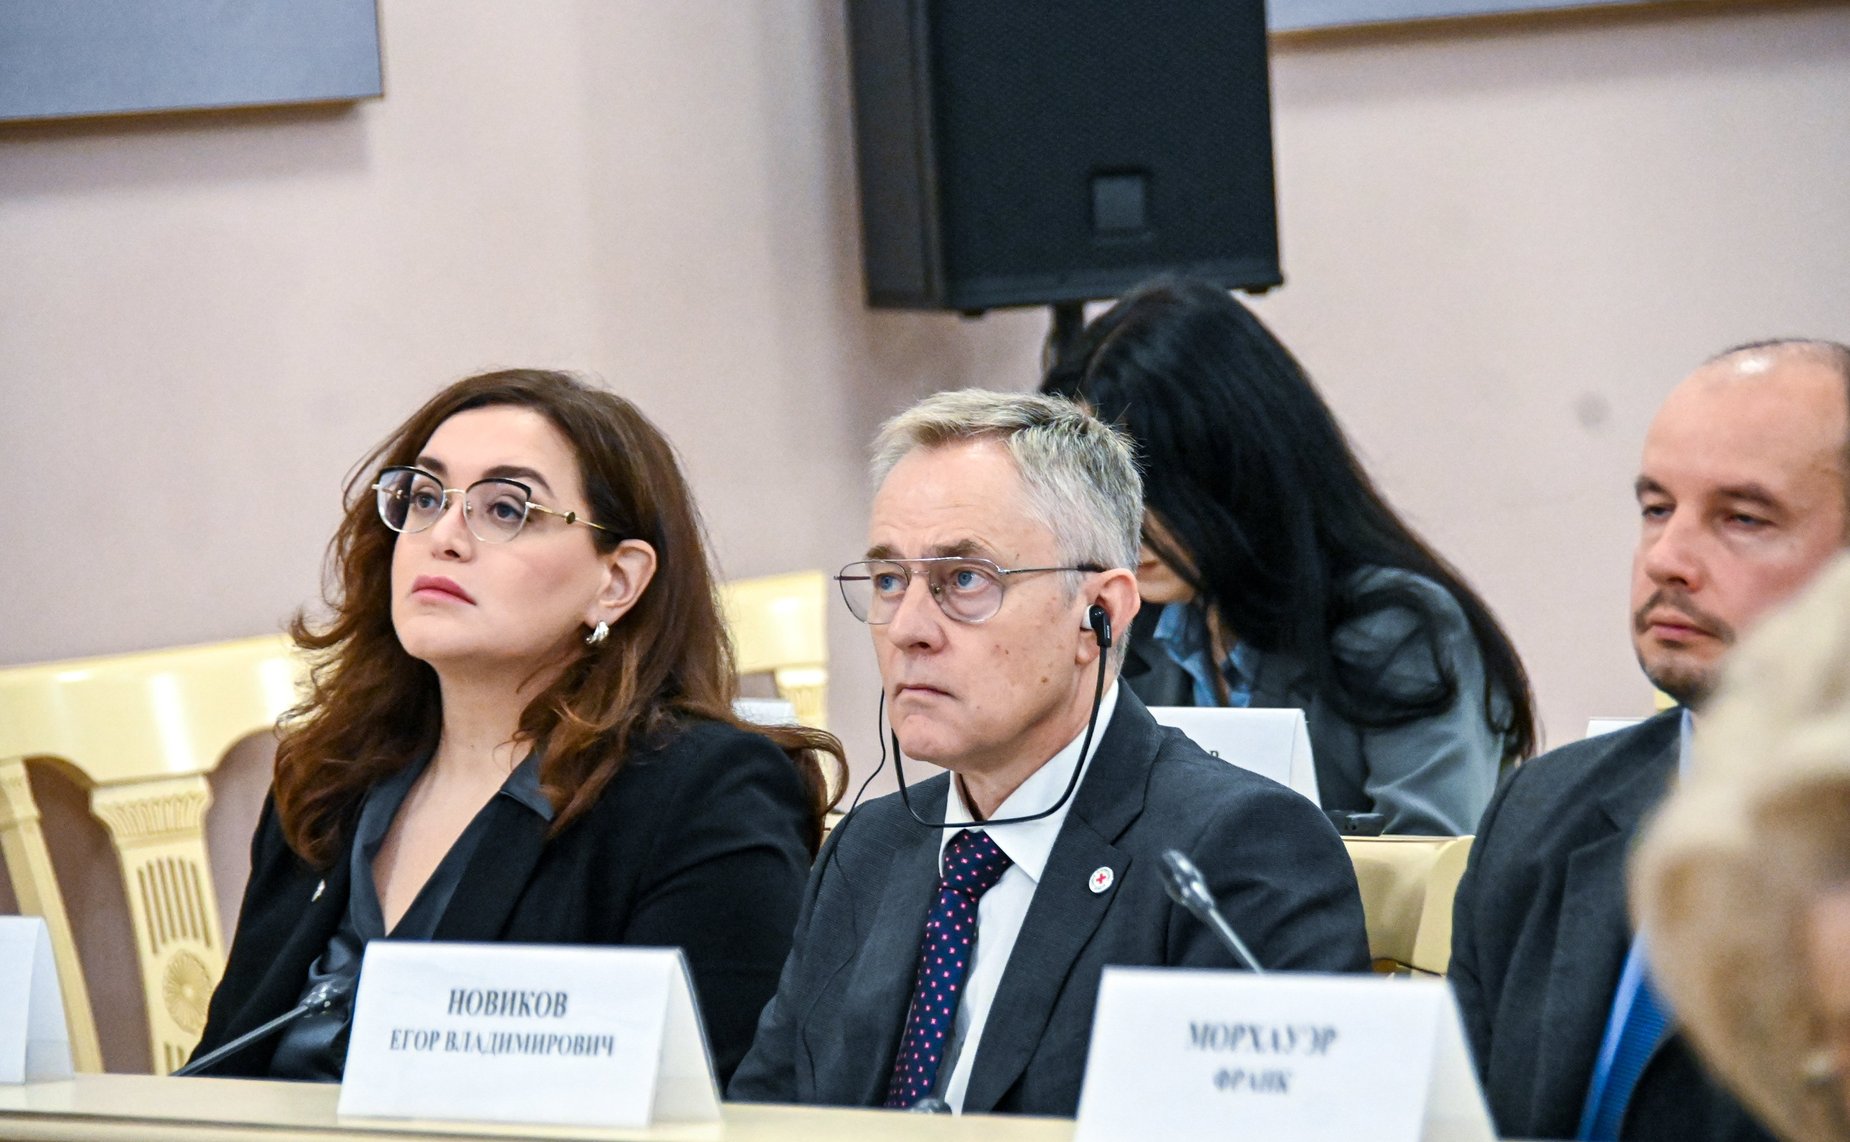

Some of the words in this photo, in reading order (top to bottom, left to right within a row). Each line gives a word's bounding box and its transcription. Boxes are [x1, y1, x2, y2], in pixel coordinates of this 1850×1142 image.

[447, 988, 568, 1018] НОВИКОВ
[389, 1029, 440, 1052] ЕГОР
[444, 1030, 614, 1057] ВЛАДИМИРОВИЧ
[1187, 1021, 1338, 1054] МОРХАУЭР
